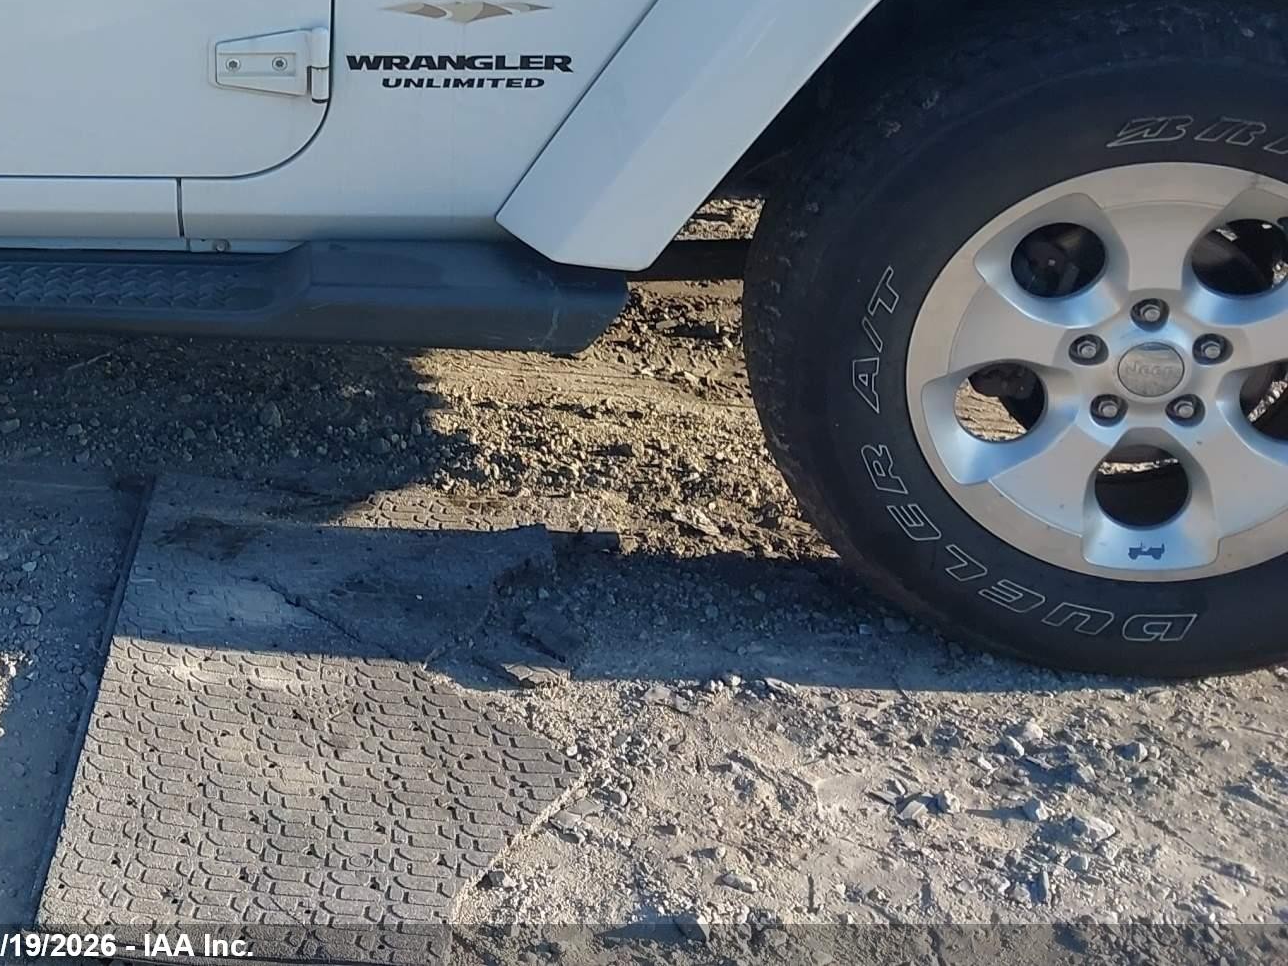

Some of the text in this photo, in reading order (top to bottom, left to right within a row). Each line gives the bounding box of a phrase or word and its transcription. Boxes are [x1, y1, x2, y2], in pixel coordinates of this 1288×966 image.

[346, 55, 573, 72] WRANGLER
[381, 78, 545, 88] UNLIMITED
[852, 265, 1197, 642] DUELER A/T
